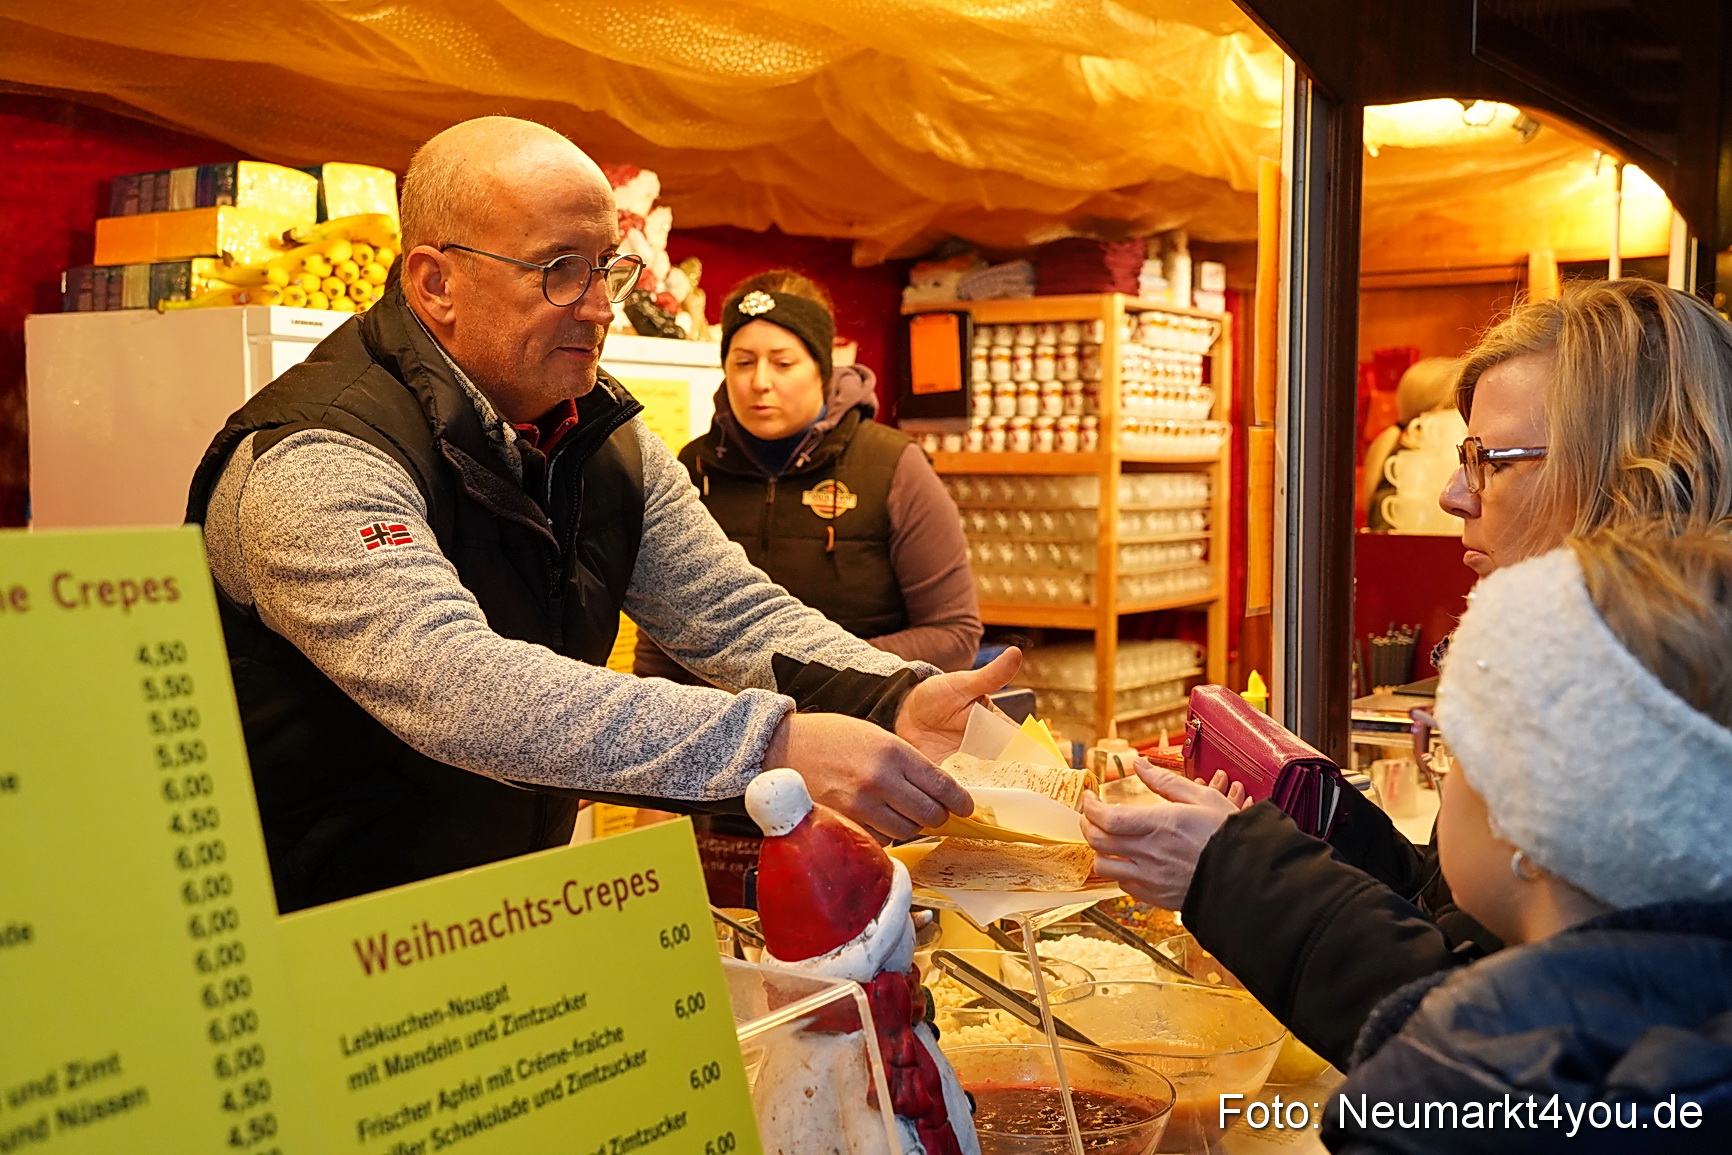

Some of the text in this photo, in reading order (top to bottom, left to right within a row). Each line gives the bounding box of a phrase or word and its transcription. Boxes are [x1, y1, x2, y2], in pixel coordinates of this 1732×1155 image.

[51, 571, 181, 615] Crepes
[136, 641, 187, 667] 4,50
[142, 674, 193, 701] 5,50
[149, 707, 200, 734] 5,50
[155, 740, 207, 768] 5,50
[354, 869, 660, 976] Weihnachts-Crepes
[659, 923, 691, 948] 6,00
[340, 983, 706, 1057] Lebkuchen-Nougat 6,00
[349, 992, 588, 1091] mit Mandeln und Zimtzucker
[356, 1100, 432, 1142] Frischer
[436, 1076, 483, 1113] Apfel
[486, 1066, 514, 1091] mit
[690, 1061, 721, 1089] 6,00
[431, 1095, 529, 1149] Schokolade
[532, 1079, 564, 1109] und
[566, 1049, 647, 1095] Zimtzucker
[608, 1111, 736, 1155] Zimtzucker 600
